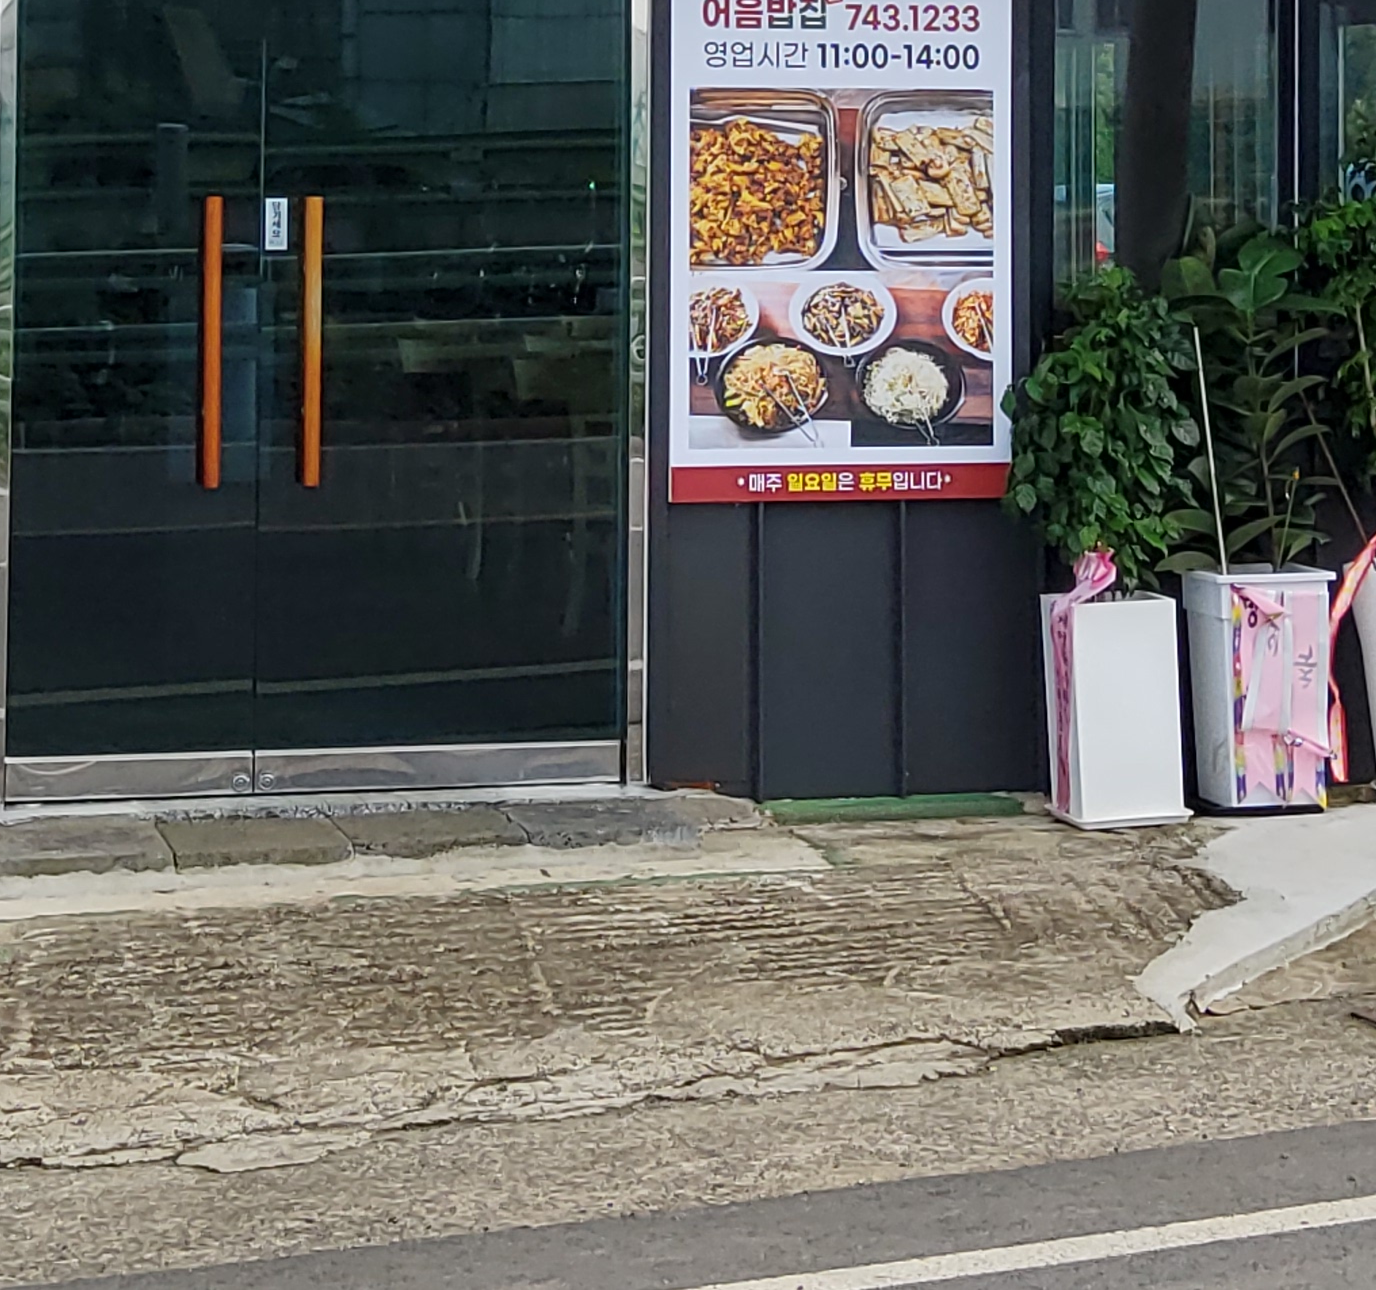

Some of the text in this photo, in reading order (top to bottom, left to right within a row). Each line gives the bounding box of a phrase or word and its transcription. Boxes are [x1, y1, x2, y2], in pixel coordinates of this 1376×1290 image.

[845, 3, 981, 32] 743.1233
[704, 41, 980, 69] 영업시간 11:00-14:00
[748, 470, 943, 493] 매주 일요일은 휴무입니다
